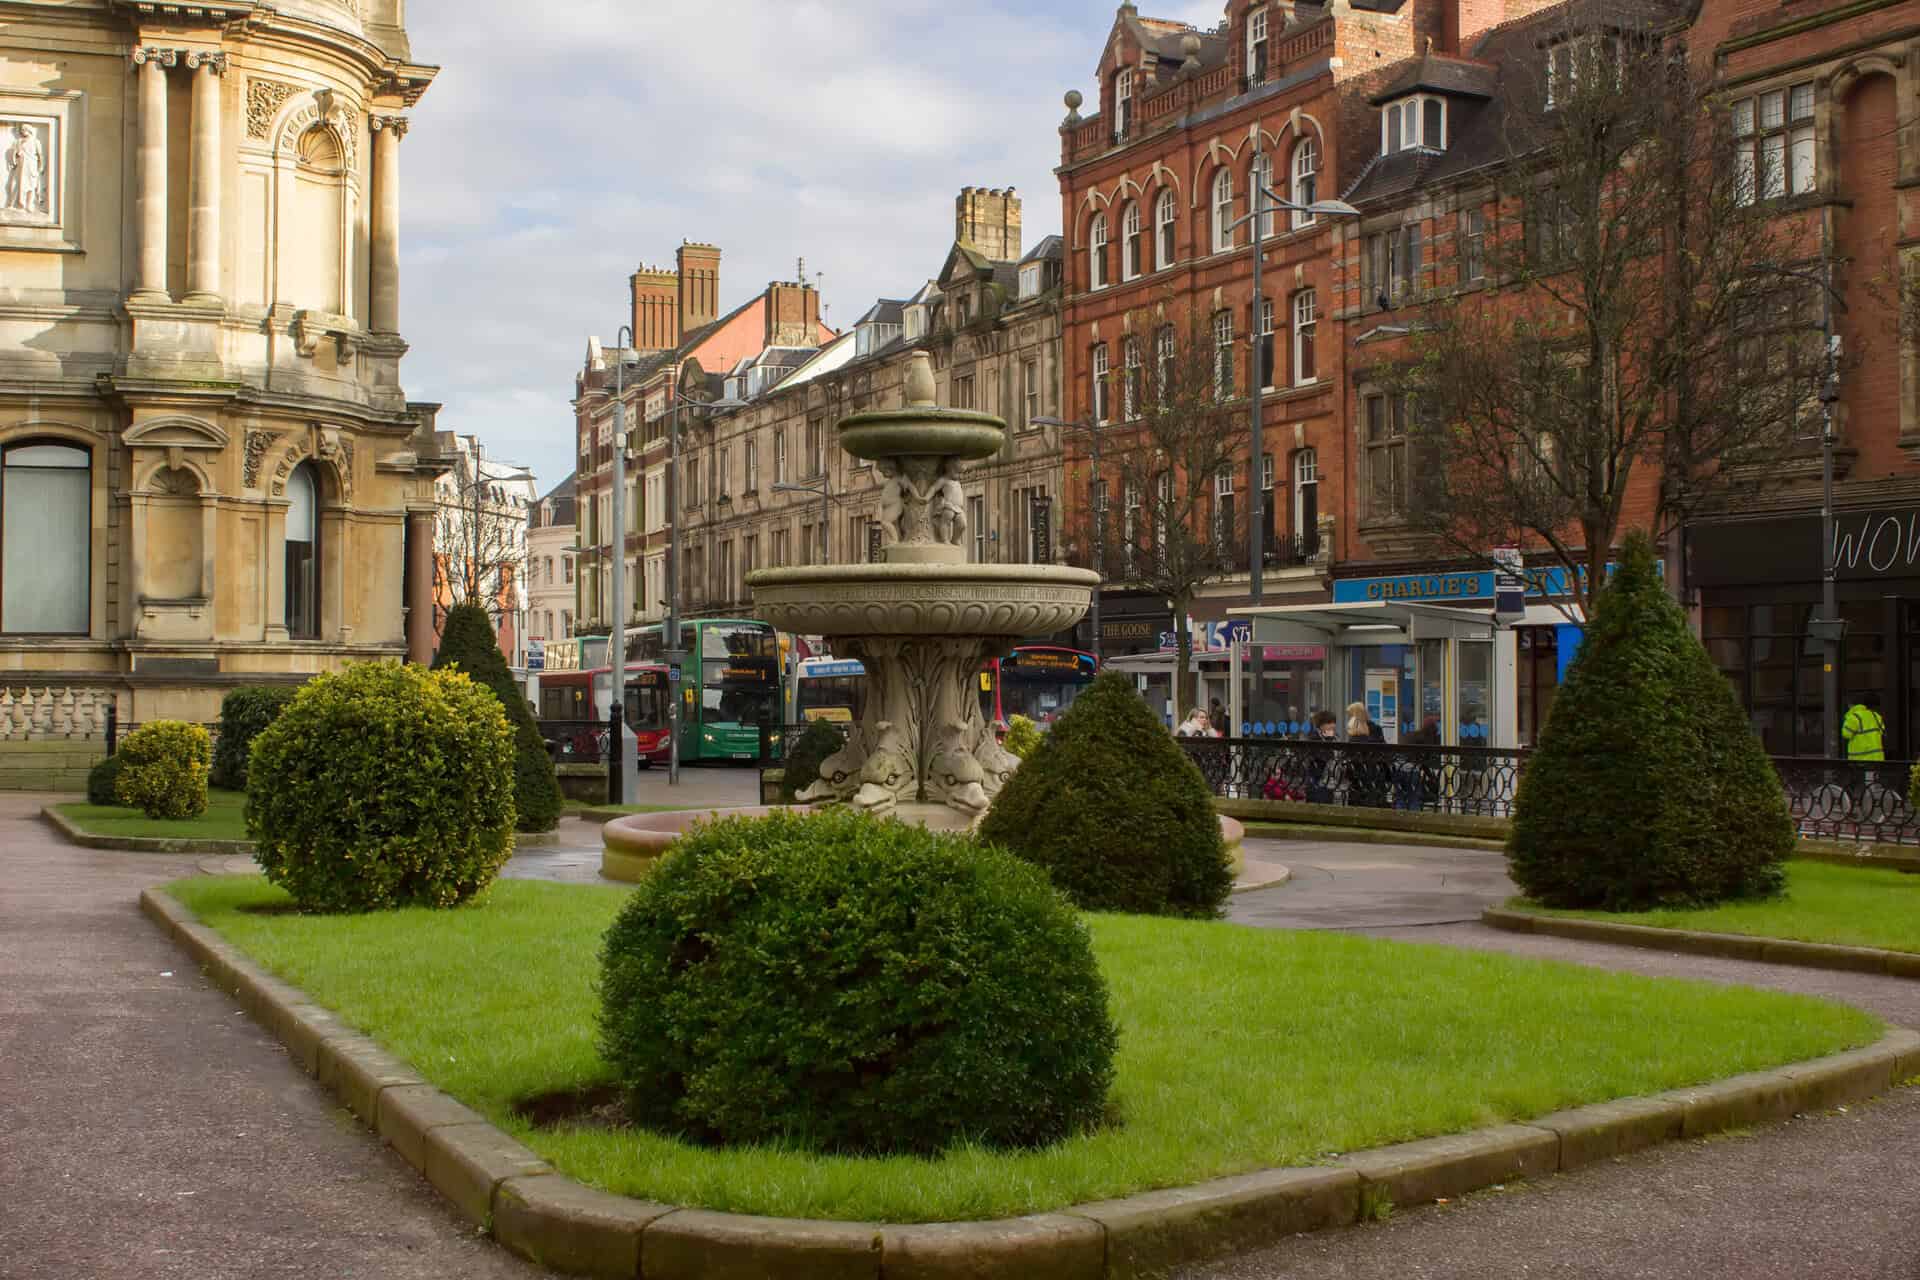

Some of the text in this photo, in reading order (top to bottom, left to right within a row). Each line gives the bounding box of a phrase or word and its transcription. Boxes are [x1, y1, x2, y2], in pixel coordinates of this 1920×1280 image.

[1366, 576, 1481, 600] CHARLIE'S
[1102, 622, 1153, 639] THE GOOSE
[1213, 620, 1229, 652] 5
[1071, 655, 1081, 671] 2
